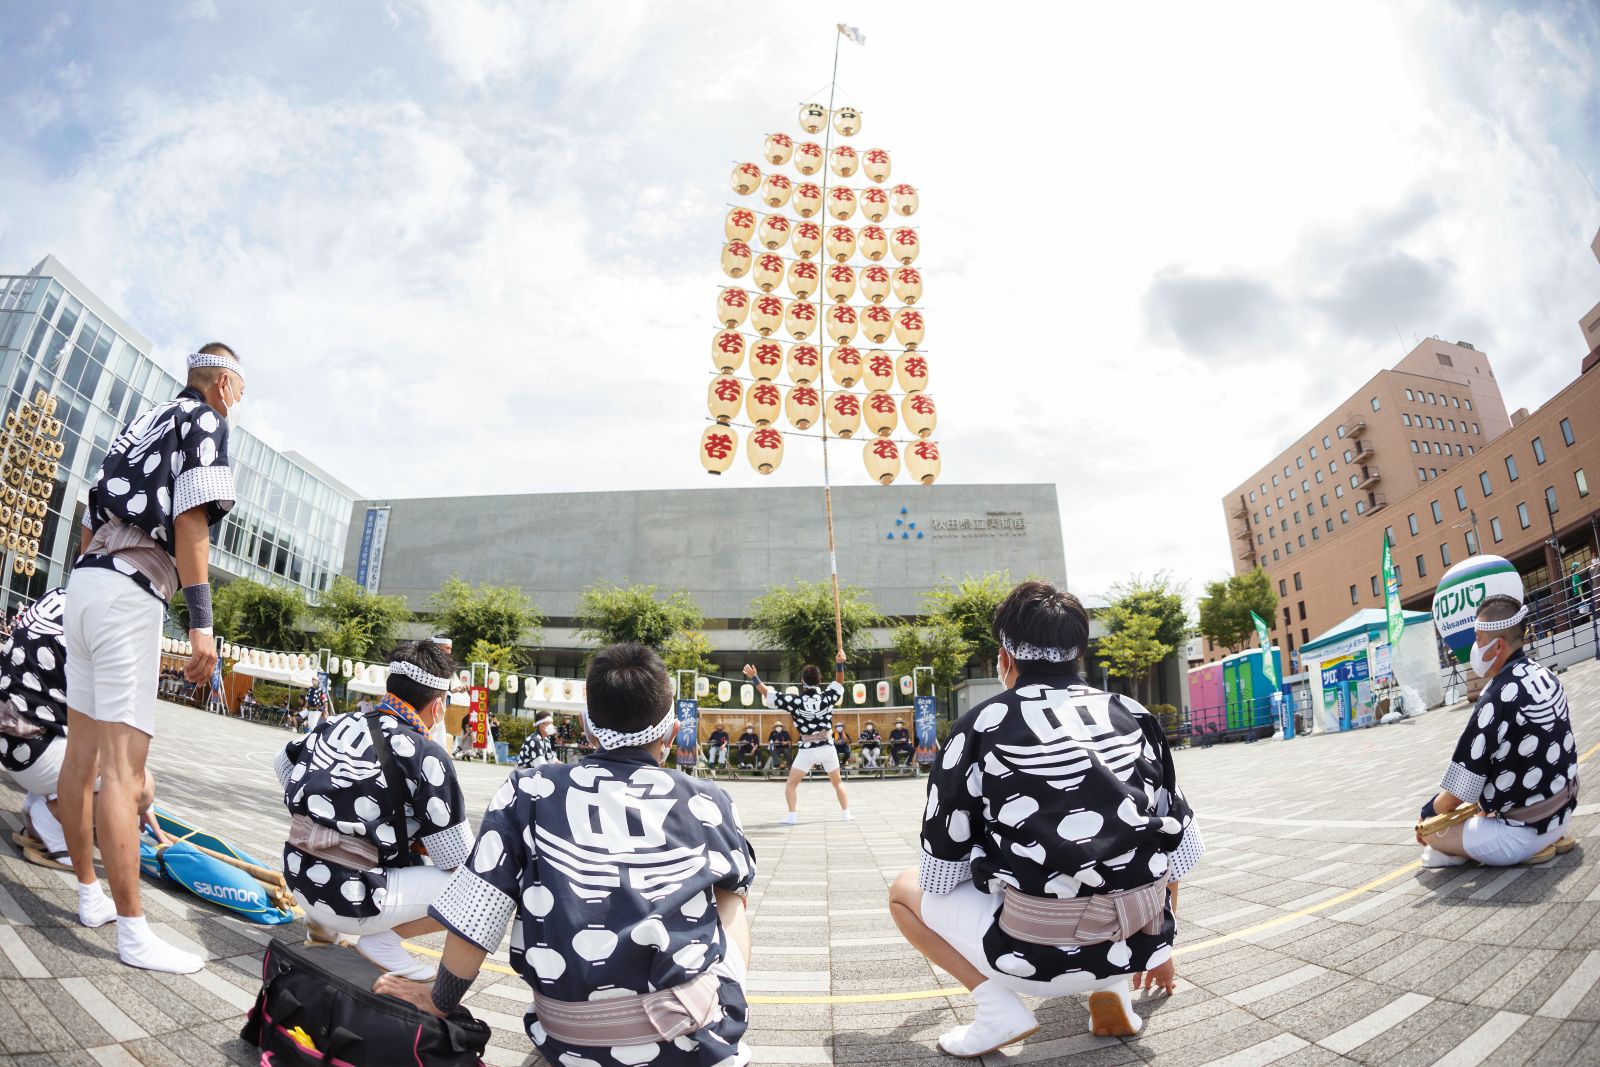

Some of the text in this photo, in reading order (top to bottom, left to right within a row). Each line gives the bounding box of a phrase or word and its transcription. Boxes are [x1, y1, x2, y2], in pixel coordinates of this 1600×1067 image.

[732, 210, 752, 228] 若
[768, 215, 788, 232] 若
[799, 223, 819, 240] 若
[896, 229, 916, 246] 若
[762, 254, 782, 273] 若
[795, 261, 816, 279] 若
[833, 266, 851, 283] 若
[866, 266, 887, 283] 若
[899, 268, 919, 285] 若
[722, 289, 746, 309] 若
[759, 296, 781, 316] 若
[792, 303, 815, 321] 若
[834, 306, 856, 324] 若
[867, 306, 890, 323] 若
[900, 311, 921, 331] 若
[720, 332, 742, 353] 若
[757, 344, 780, 365] 若
[794, 345, 817, 366] 若
[838, 347, 859, 365] 若
[869, 355, 892, 377] 若
[905, 357, 926, 378] 若
[715, 378, 740, 401] 若
[754, 384, 778, 406] 若
[792, 387, 818, 406] 若
[834, 394, 858, 416] 若
[872, 394, 895, 413] 若
[912, 394, 935, 415] 若
[704, 434, 732, 459] 若
[753, 429, 781, 449] 若
[872, 440, 897, 460] 若
[914, 441, 939, 460] 若
